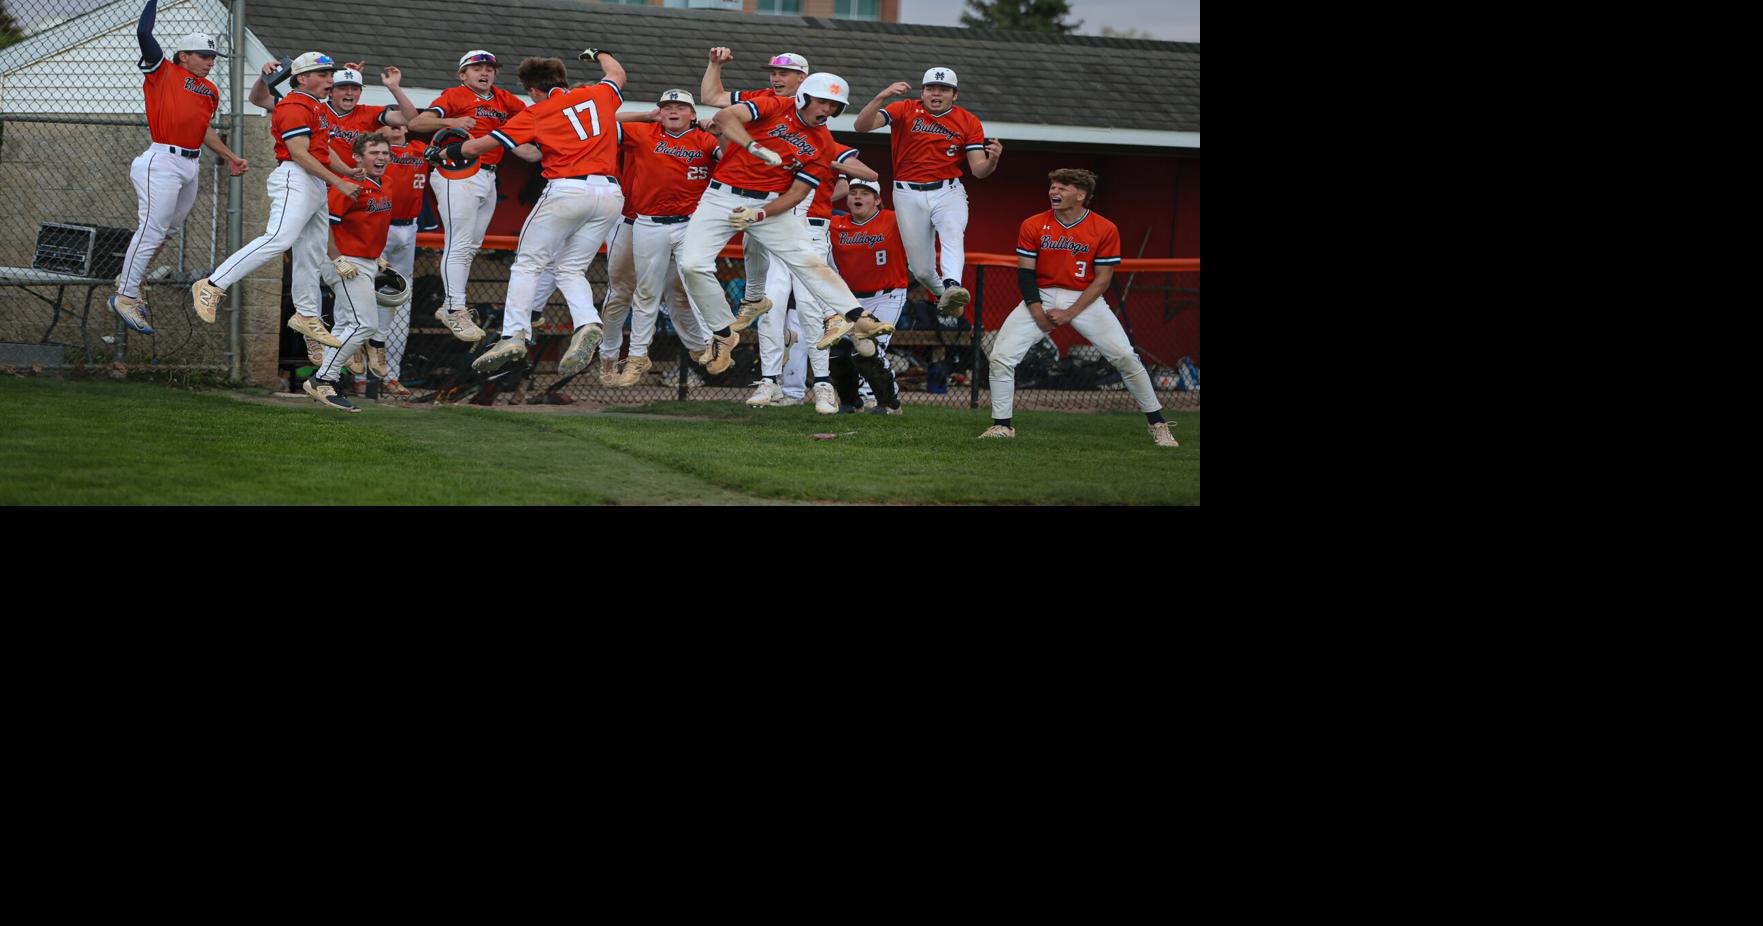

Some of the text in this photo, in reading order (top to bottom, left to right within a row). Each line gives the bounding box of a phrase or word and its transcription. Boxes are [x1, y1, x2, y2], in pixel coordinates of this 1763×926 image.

[562, 98, 602, 142] 17
[654, 140, 704, 163] Bulldogs
[413, 173, 426, 189] 22
[687, 166, 709, 180] 25
[839, 231, 884, 248] Bulldogs
[1040, 234, 1090, 256] Bulldogs
[875, 249, 887, 266] 8
[1074, 260, 1087, 278] 3
